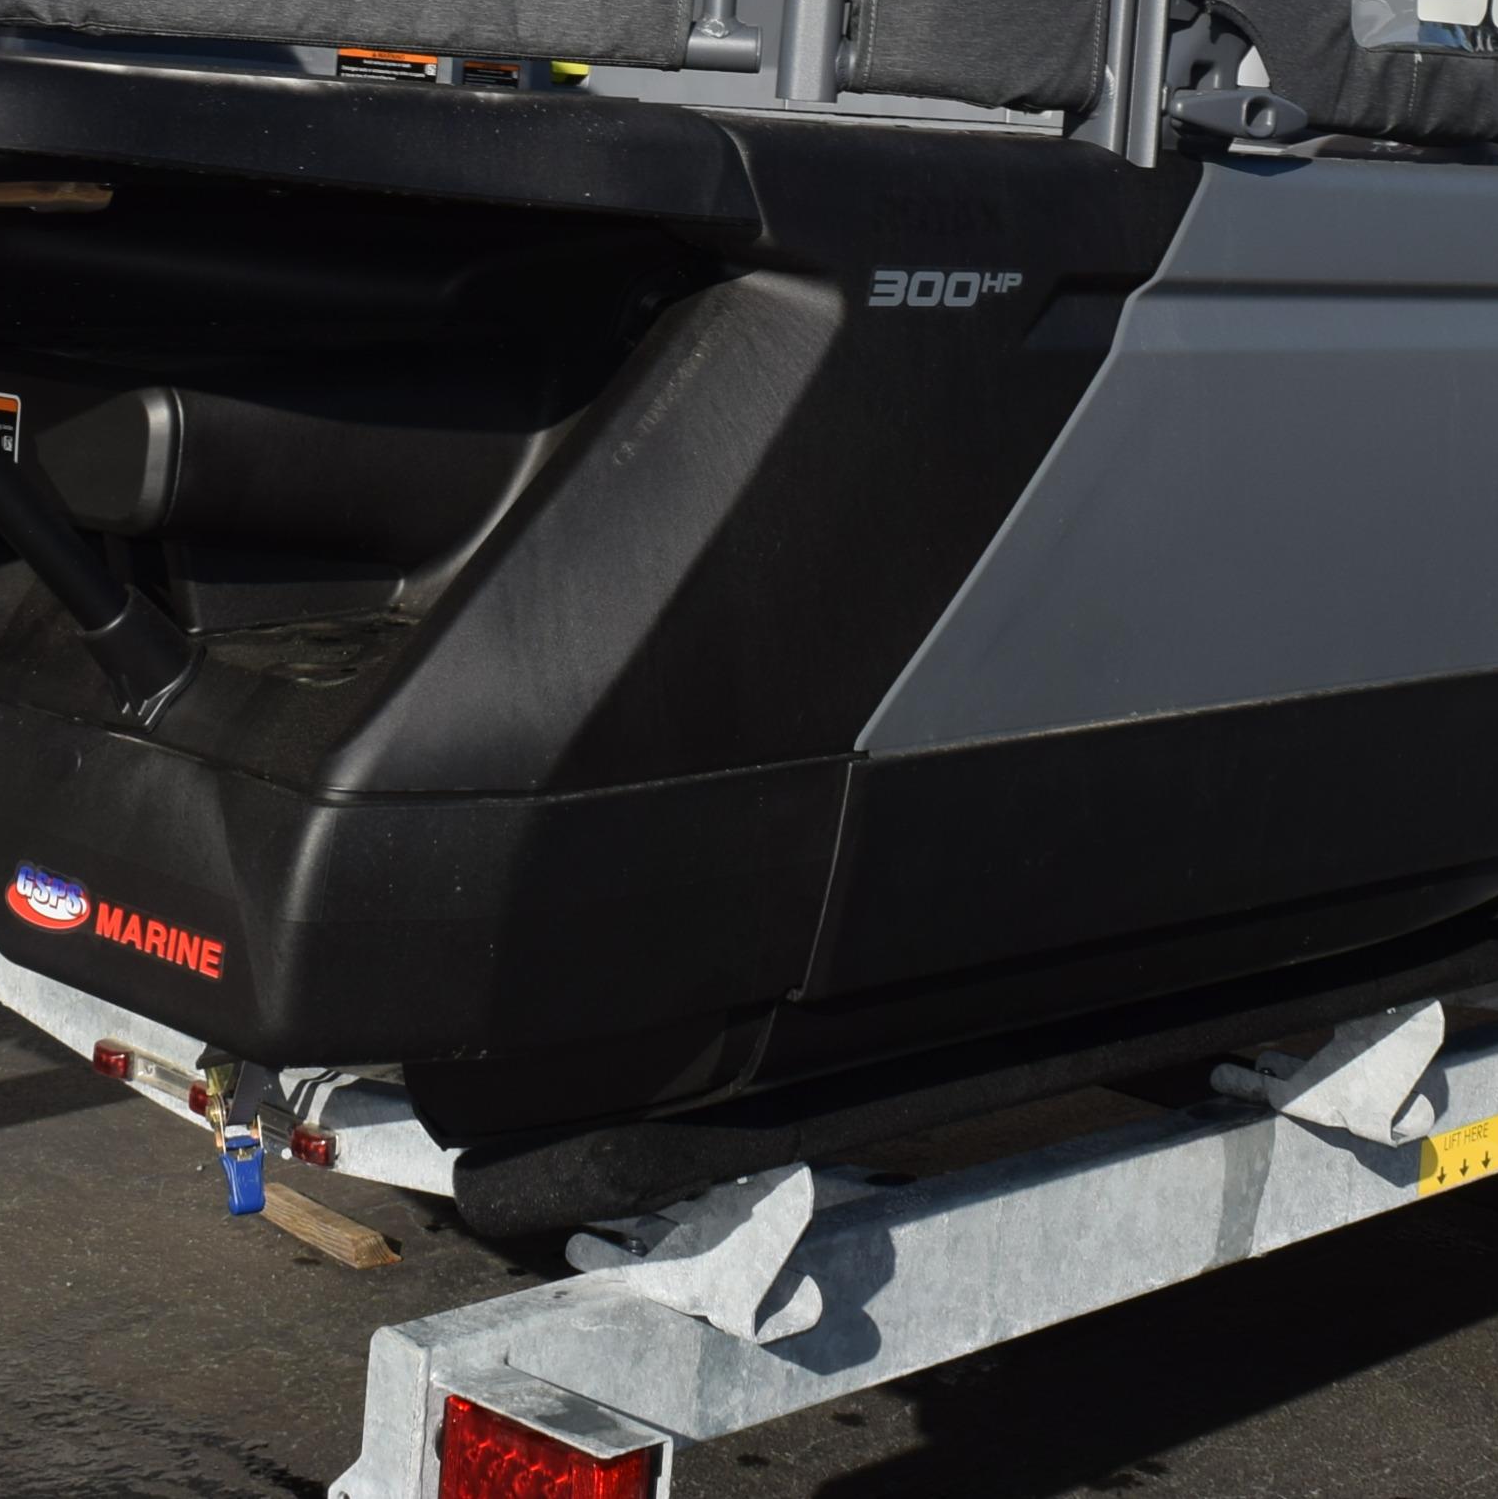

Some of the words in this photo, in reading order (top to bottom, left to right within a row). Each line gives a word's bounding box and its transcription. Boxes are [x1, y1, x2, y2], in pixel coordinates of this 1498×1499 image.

[15, 865, 85, 916] GSPS
[95, 901, 224, 979] MARINE
[1443, 1132, 1461, 1151] LIFT
[1464, 1122, 1490, 1144] HERE
